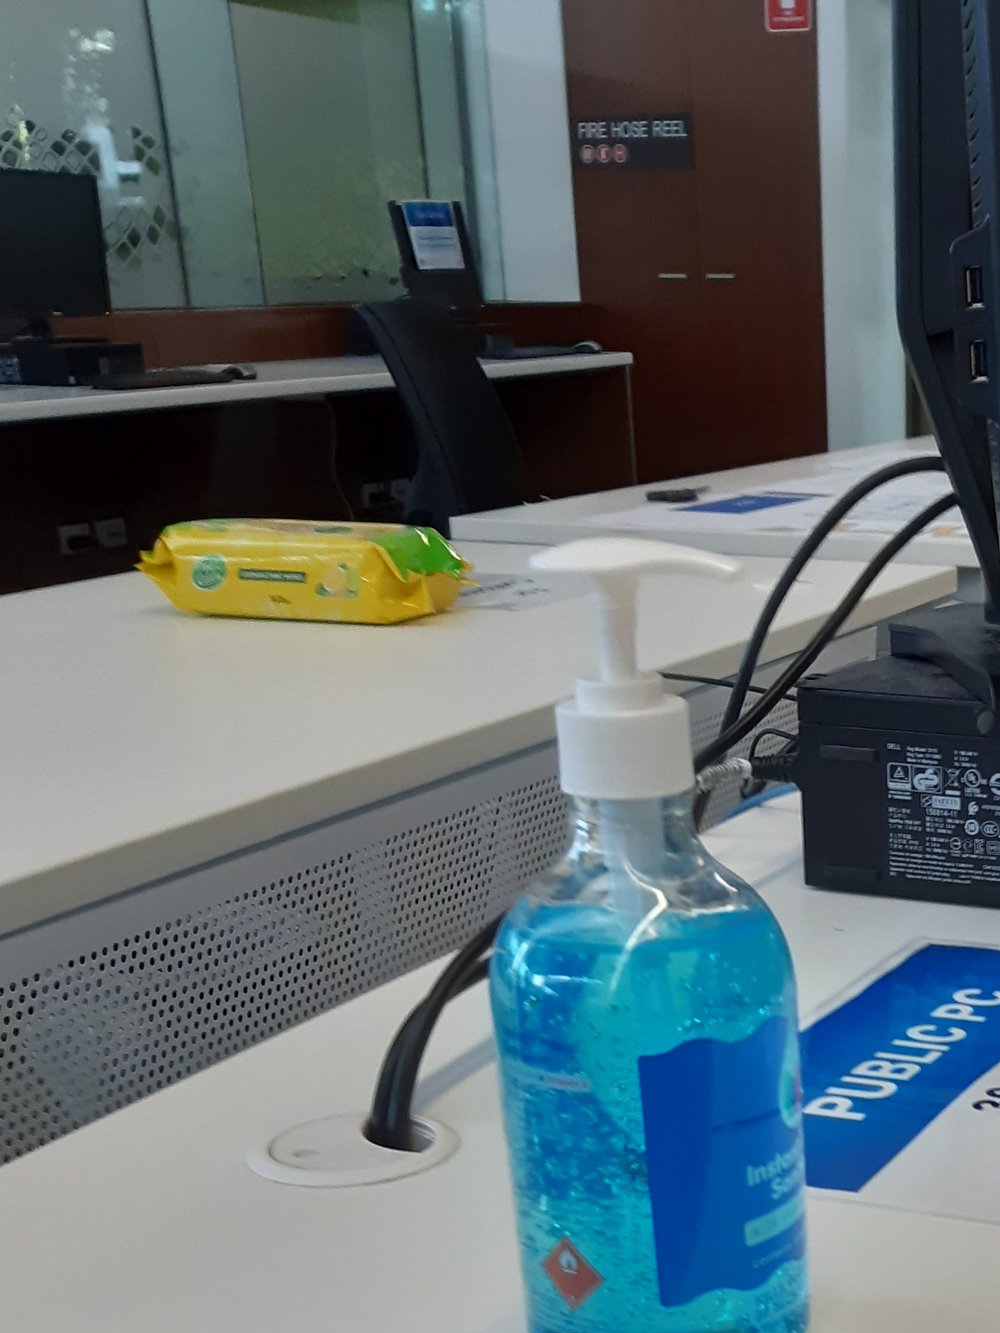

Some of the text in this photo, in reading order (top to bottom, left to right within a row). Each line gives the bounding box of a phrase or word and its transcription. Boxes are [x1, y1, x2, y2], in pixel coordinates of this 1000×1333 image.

[578, 120, 688, 139] FIRE HOSE REEL
[801, 1024, 968, 1122] PUBLIC
